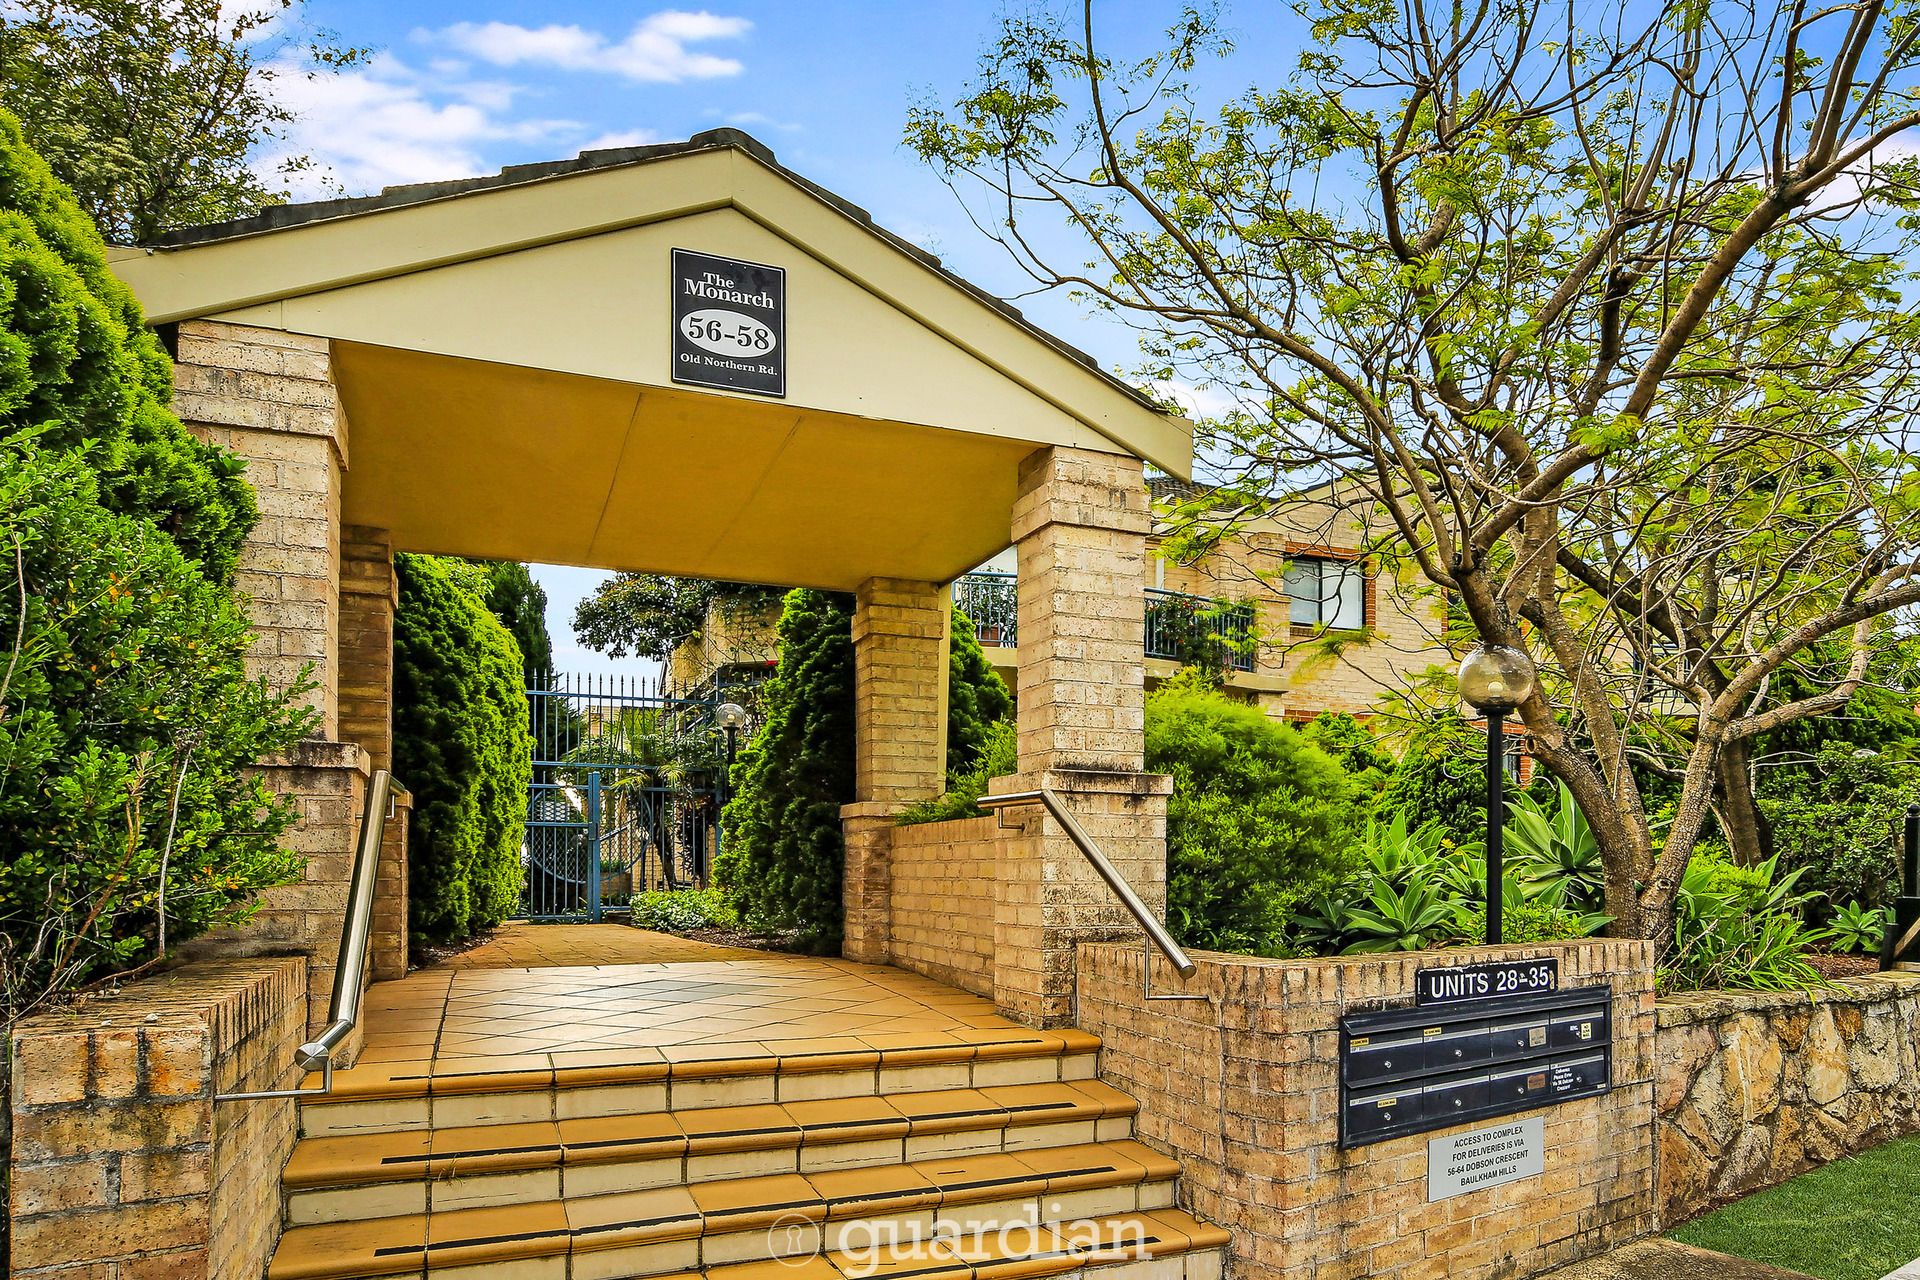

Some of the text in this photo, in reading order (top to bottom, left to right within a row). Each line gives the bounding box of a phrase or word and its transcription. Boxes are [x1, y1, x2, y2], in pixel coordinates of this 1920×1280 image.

[703, 272, 734, 288] The
[684, 278, 774, 309] Monarch
[688, 317, 770, 350] 56-58
[680, 353, 778, 376] Old Northern Rd.
[1431, 966, 1549, 998] UNITS 28-35
[1454, 1126, 1523, 1148] ACCESS TO COMPLEX
[1452, 1138, 1524, 1162] FOR DELIVERIES IS VIA
[1448, 1150, 1529, 1176] 56-64 DOBSON CRESCENT
[1460, 1165, 1517, 1186] BAULKHAM HILLS
